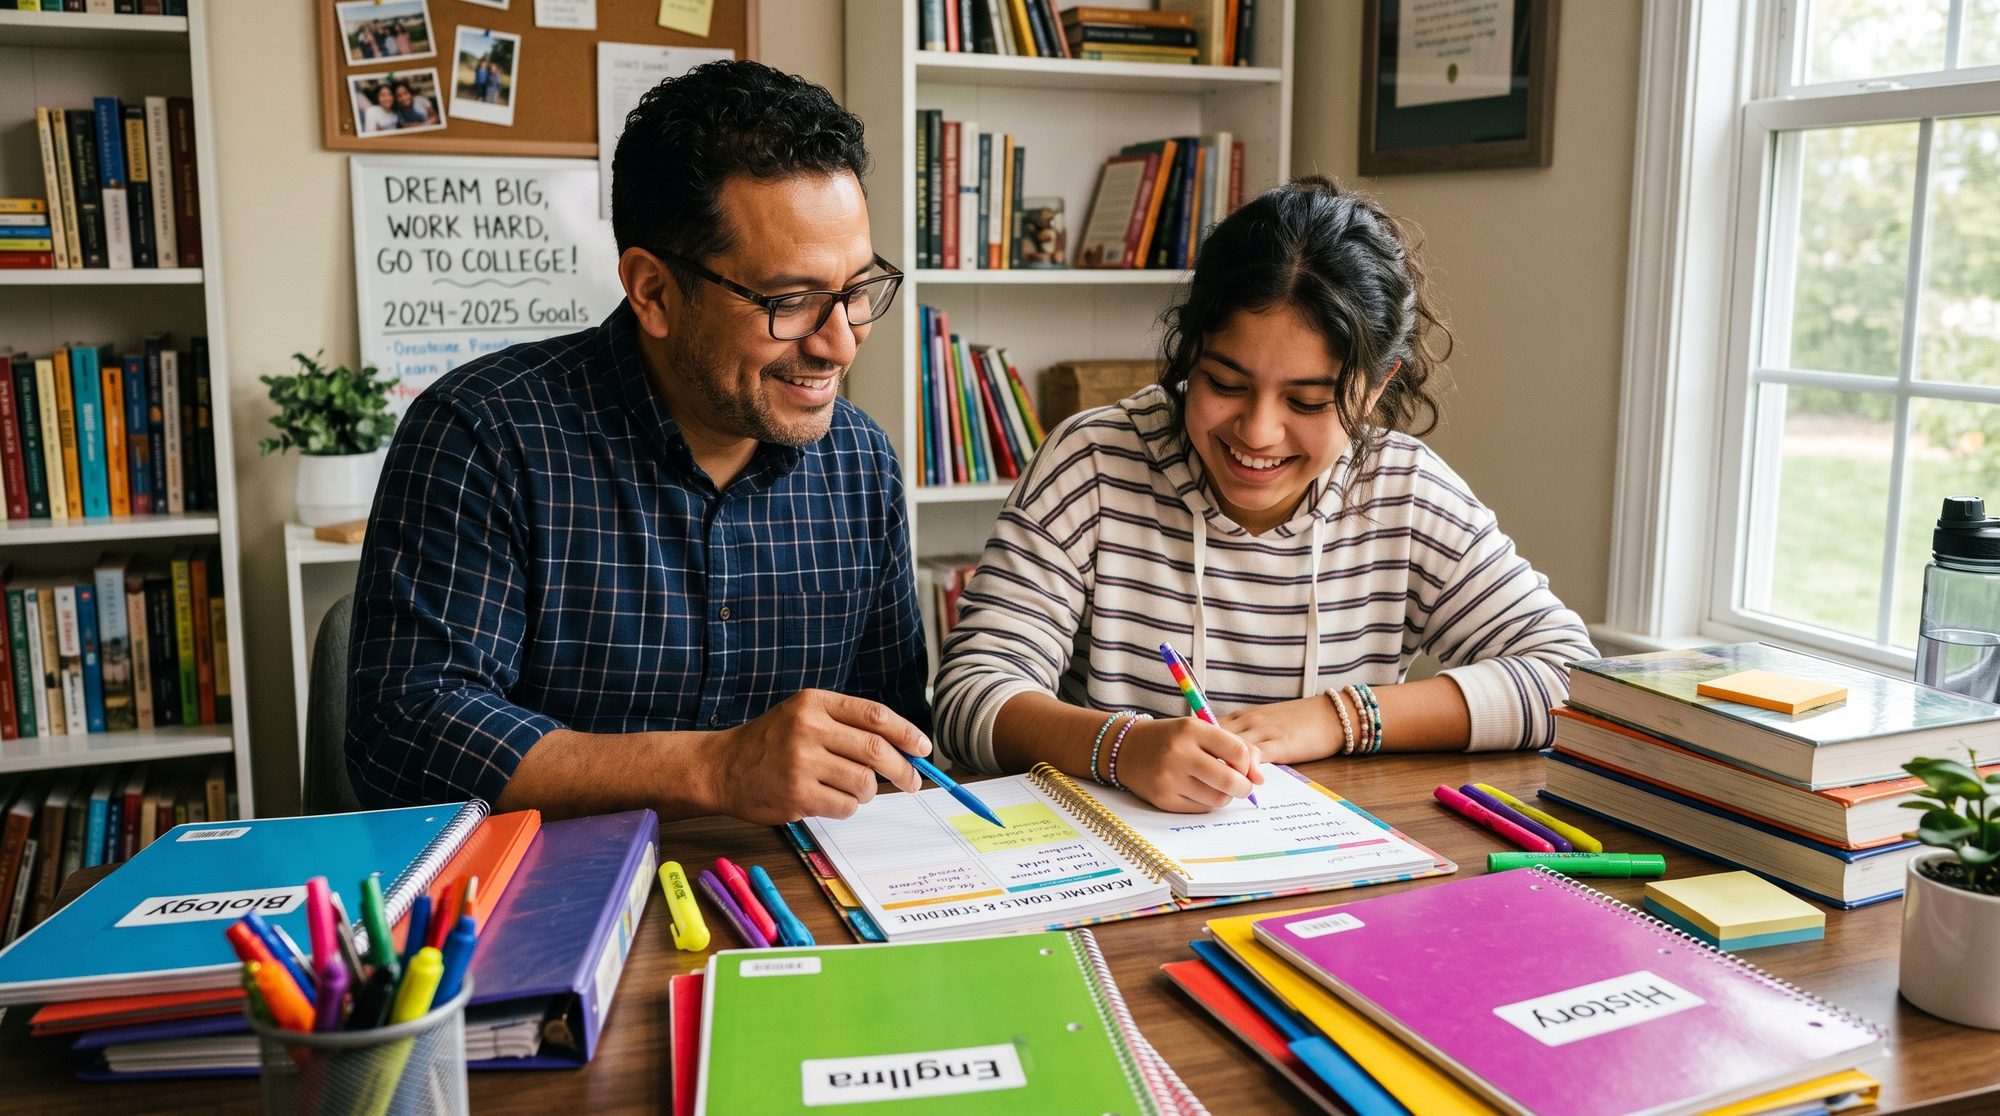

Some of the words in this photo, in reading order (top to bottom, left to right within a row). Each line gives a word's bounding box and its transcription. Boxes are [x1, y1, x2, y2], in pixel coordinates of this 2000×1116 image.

[385, 176, 482, 205] DREAM
[496, 177, 550, 210] BIG,
[387, 214, 462, 240] WORK
[473, 214, 550, 243] HARD,
[377, 247, 413, 275] GO
[420, 247, 452, 274] TO
[462, 245, 578, 275] COLLEGE!
[382, 299, 520, 328] 2024-2025
[528, 297, 590, 325] Goals
[1004, 892, 1053, 910] GOALS
[1058, 878, 1134, 902] ACADEMIC
[144, 894, 293, 916] Biology
[984, 902, 997, 912] &
[1532, 985, 1677, 1029] History
